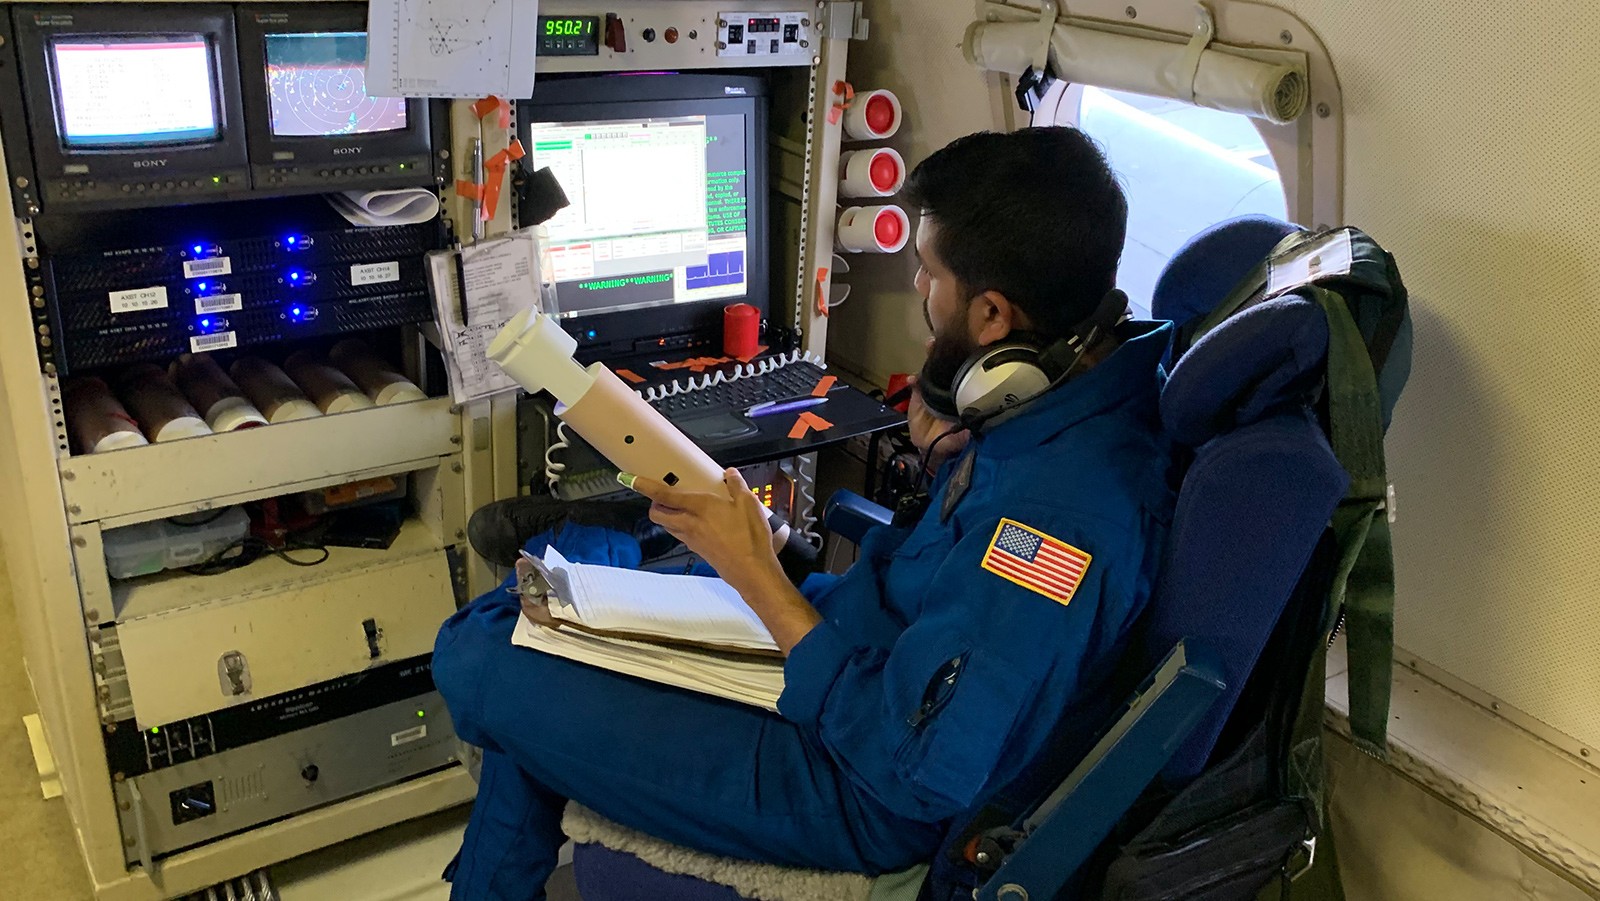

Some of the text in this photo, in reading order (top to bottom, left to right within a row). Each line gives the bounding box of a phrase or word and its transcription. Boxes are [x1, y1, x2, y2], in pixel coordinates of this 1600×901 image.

[546, 20, 592, 35] 950.21
[333, 147, 362, 155] SONY
[133, 159, 167, 168] SONY
